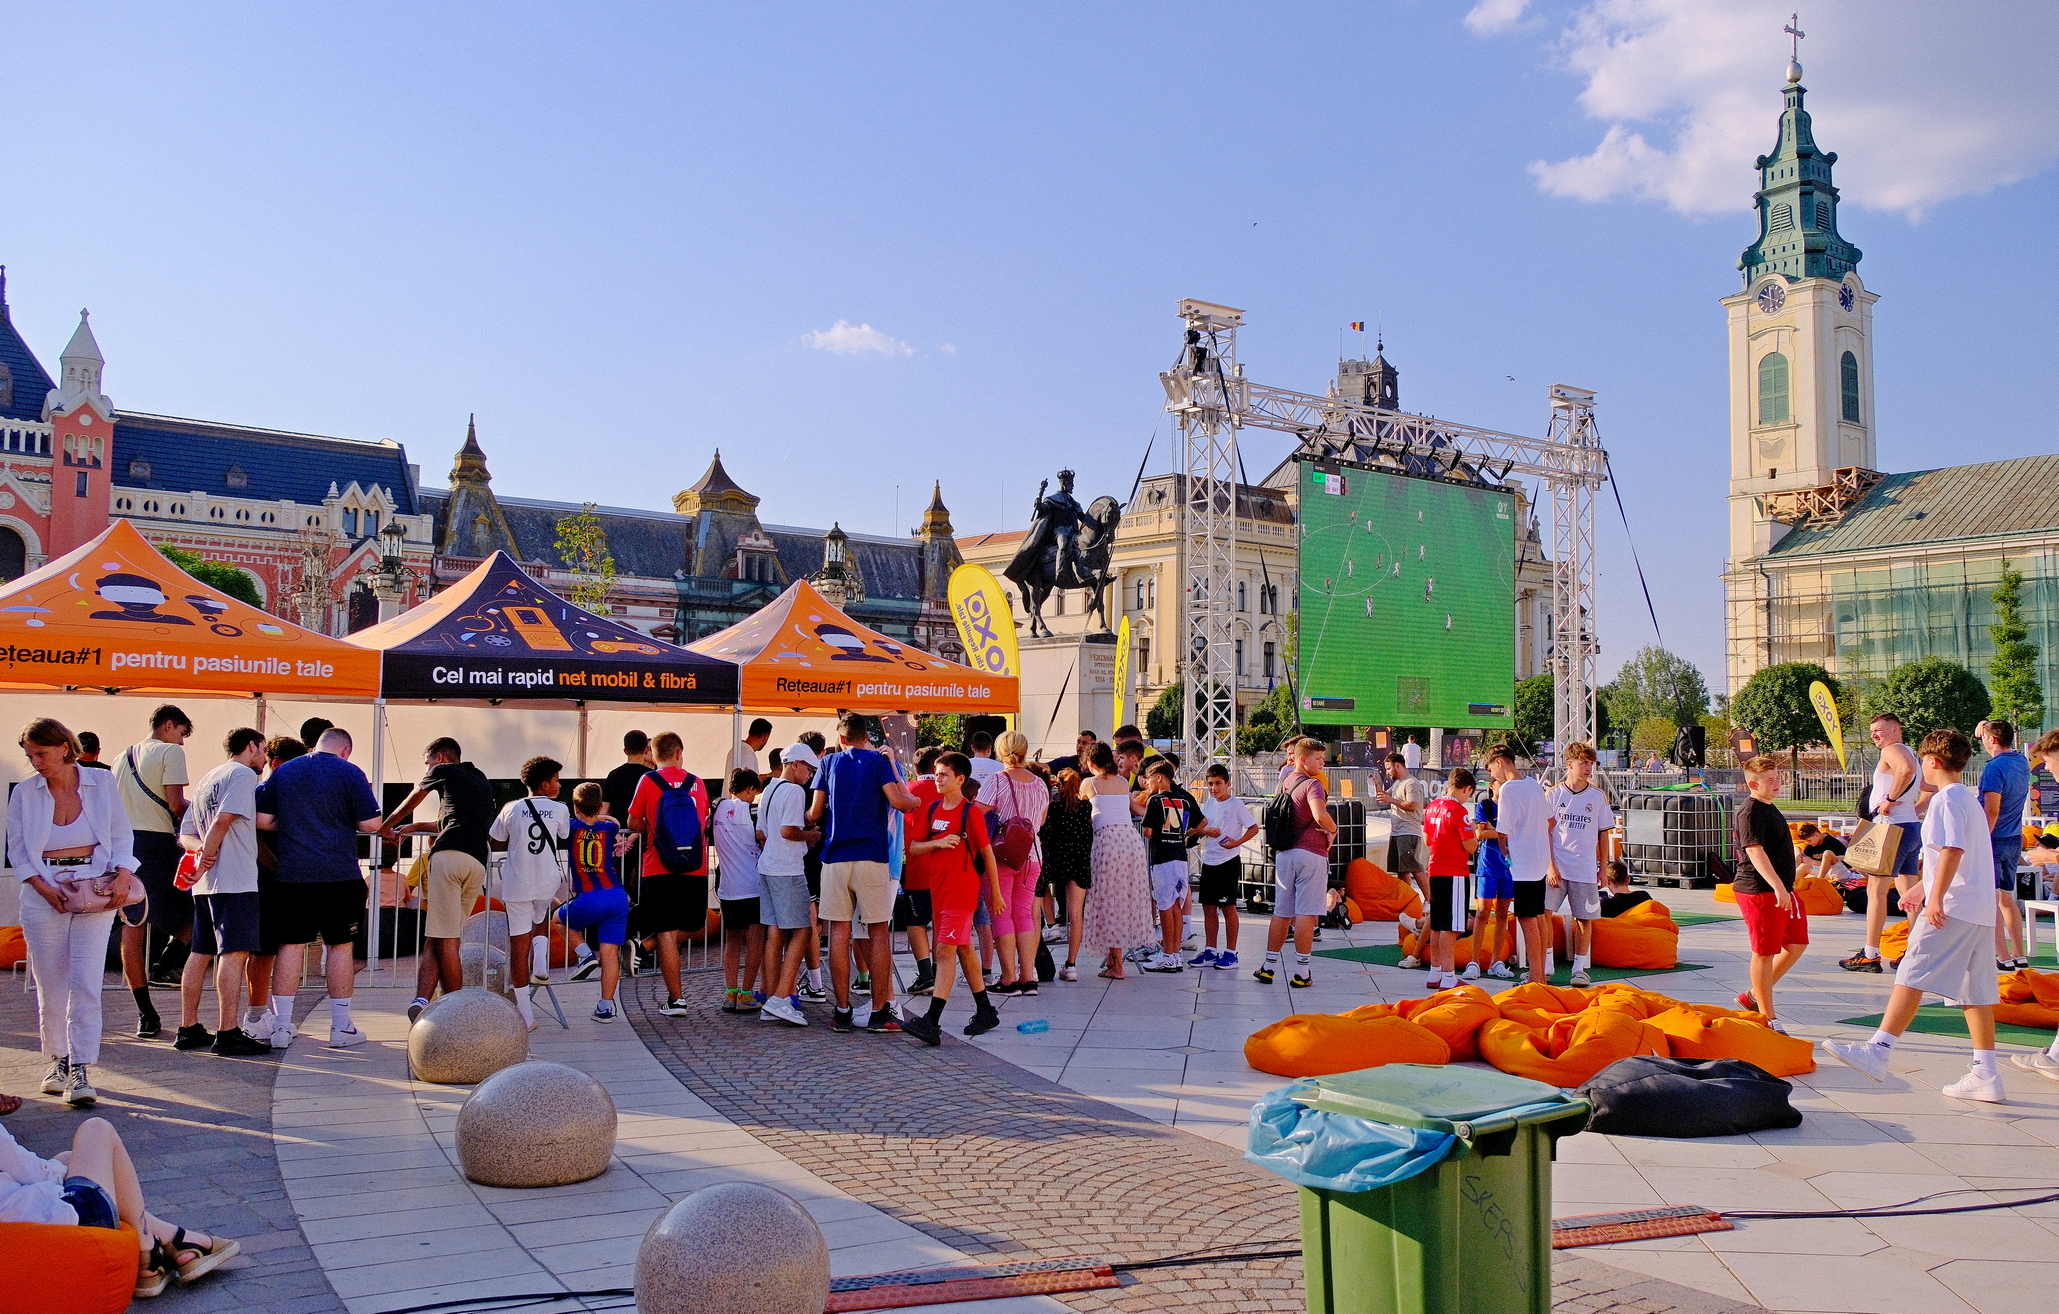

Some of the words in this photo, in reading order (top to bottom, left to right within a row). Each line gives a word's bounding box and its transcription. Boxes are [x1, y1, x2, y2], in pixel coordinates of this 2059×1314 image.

[0, 644, 102, 669] ețeaua#1
[111, 651, 186, 672] pentru
[193, 656, 291, 675] pasiunile
[296, 660, 334, 678] tale
[432, 667, 463, 684] Cel
[469, 668, 502, 685] mai
[508, 669, 554, 689] rapid
[559, 671, 587, 687] net
[591, 671, 637, 688] mobil
[643, 673, 655, 688] &
[660, 672, 696, 690] fibră
[776, 677, 852, 698] Rețeaua#1
[856, 681, 901, 698] pentru
[905, 684, 964, 699] pasiunile
[967, 684, 991, 699] tale
[578, 830, 603, 839] MESSI
[932, 819, 950, 831] NIKE
[1430, 817, 1440, 838] 7
[1568, 821, 1587, 830] BETTER
[527, 822, 546, 855] 9
[576, 839, 603, 868] 10
